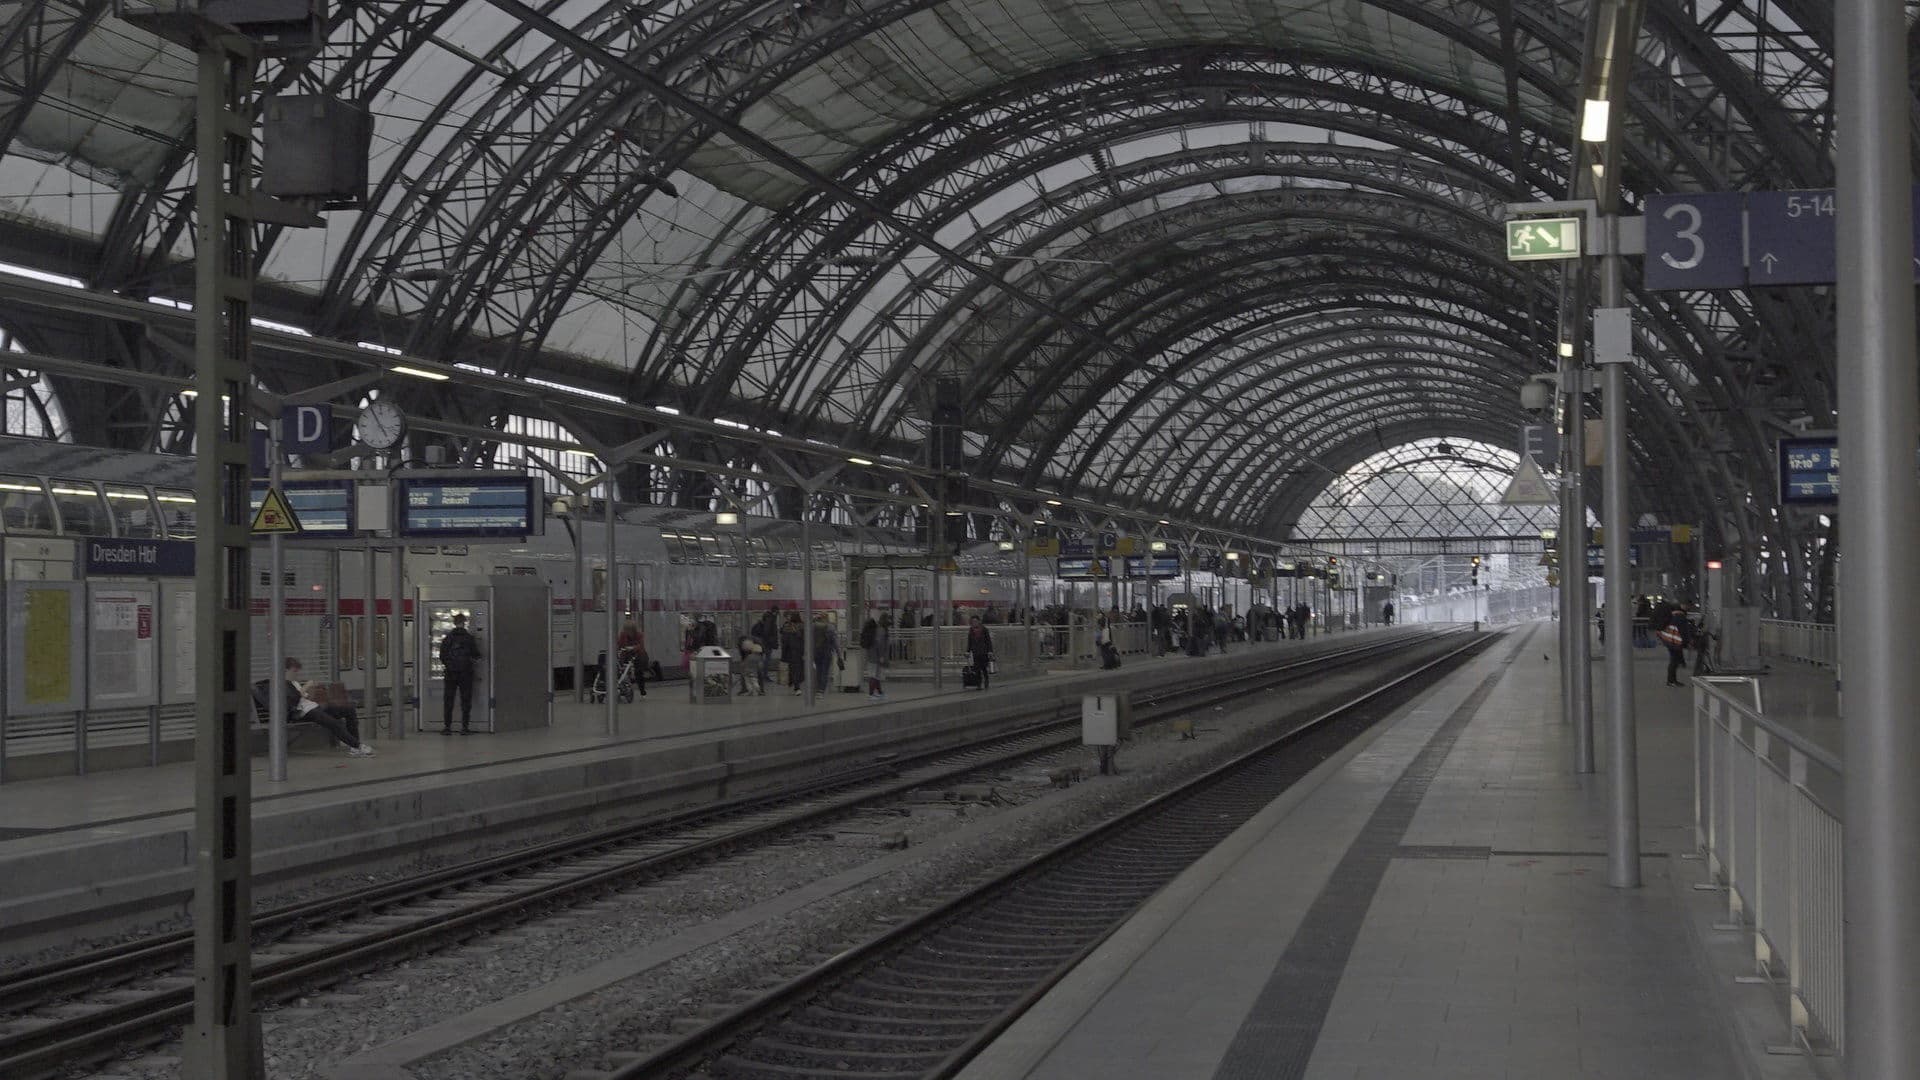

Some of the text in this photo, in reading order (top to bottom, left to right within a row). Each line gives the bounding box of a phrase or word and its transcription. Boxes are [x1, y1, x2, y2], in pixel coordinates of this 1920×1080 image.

[1787, 195, 1836, 218] 5-14
[1661, 203, 1705, 270] 3
[297, 406, 322, 442] D
[1524, 426, 1543, 453] E
[93, 543, 158, 564] Dresden Hbf
